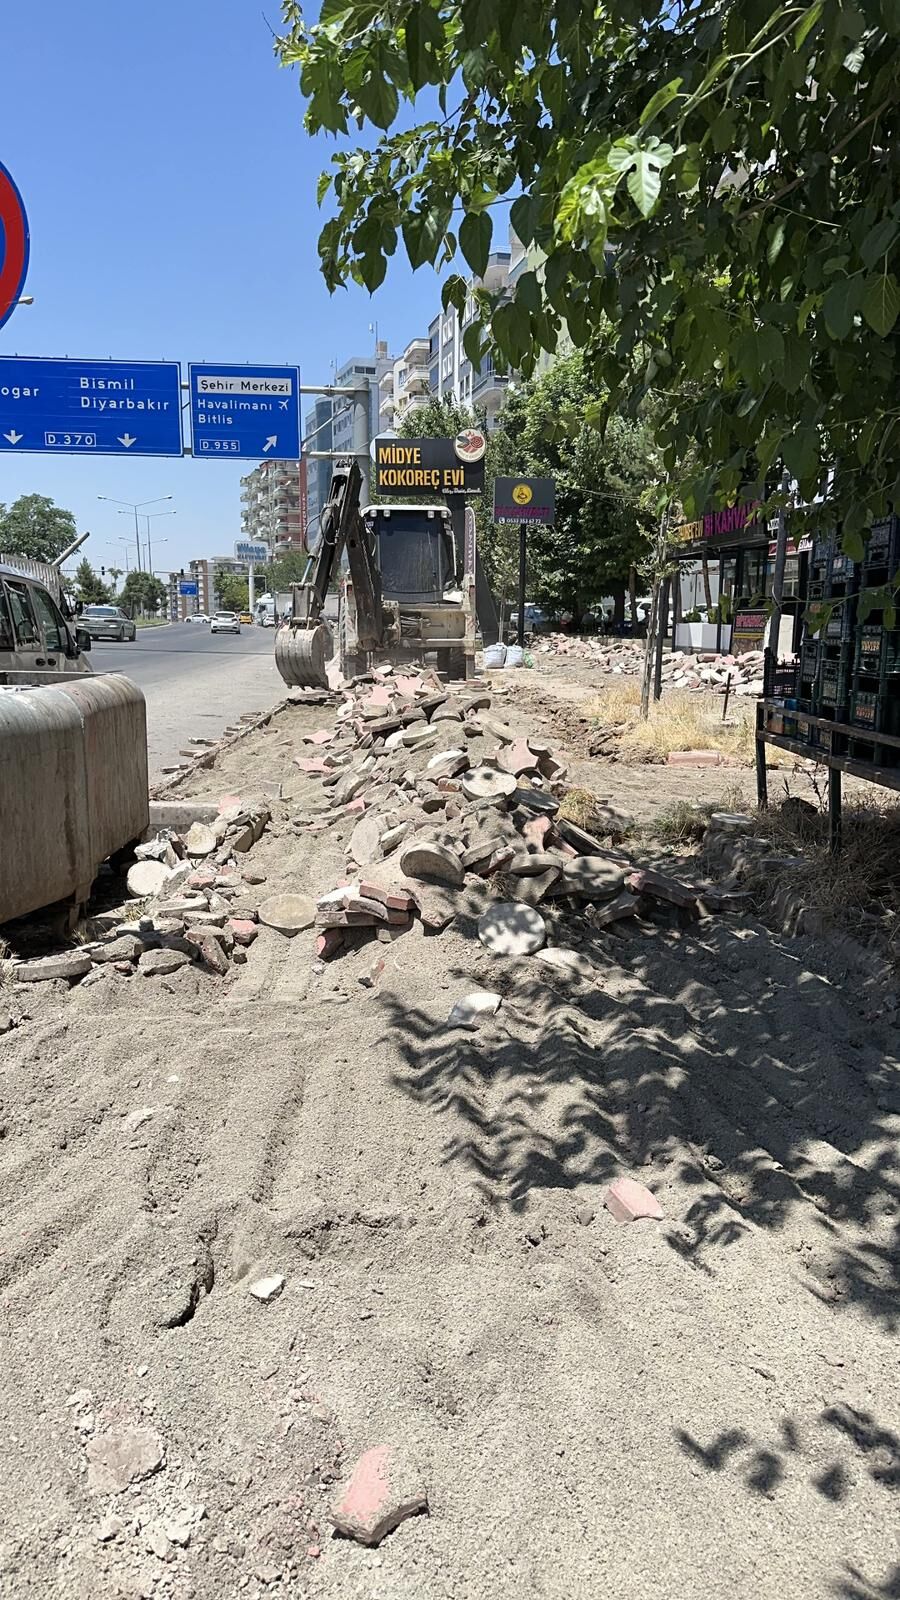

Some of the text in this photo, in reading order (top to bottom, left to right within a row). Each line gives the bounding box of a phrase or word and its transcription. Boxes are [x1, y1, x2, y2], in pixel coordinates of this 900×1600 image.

[80, 377, 134, 390] Bismil
[201, 379, 289, 392] Şehir Merkezi
[81, 396, 169, 412] Diyarbakır
[197, 398, 272, 411] Havalimanı
[198, 413, 233, 425] Bitlis
[47, 434, 93, 445] D.370
[202, 441, 237, 450] D.955
[378, 443, 421, 464] MİDYE
[379, 465, 465, 490] KOKOREÇ EVİ
